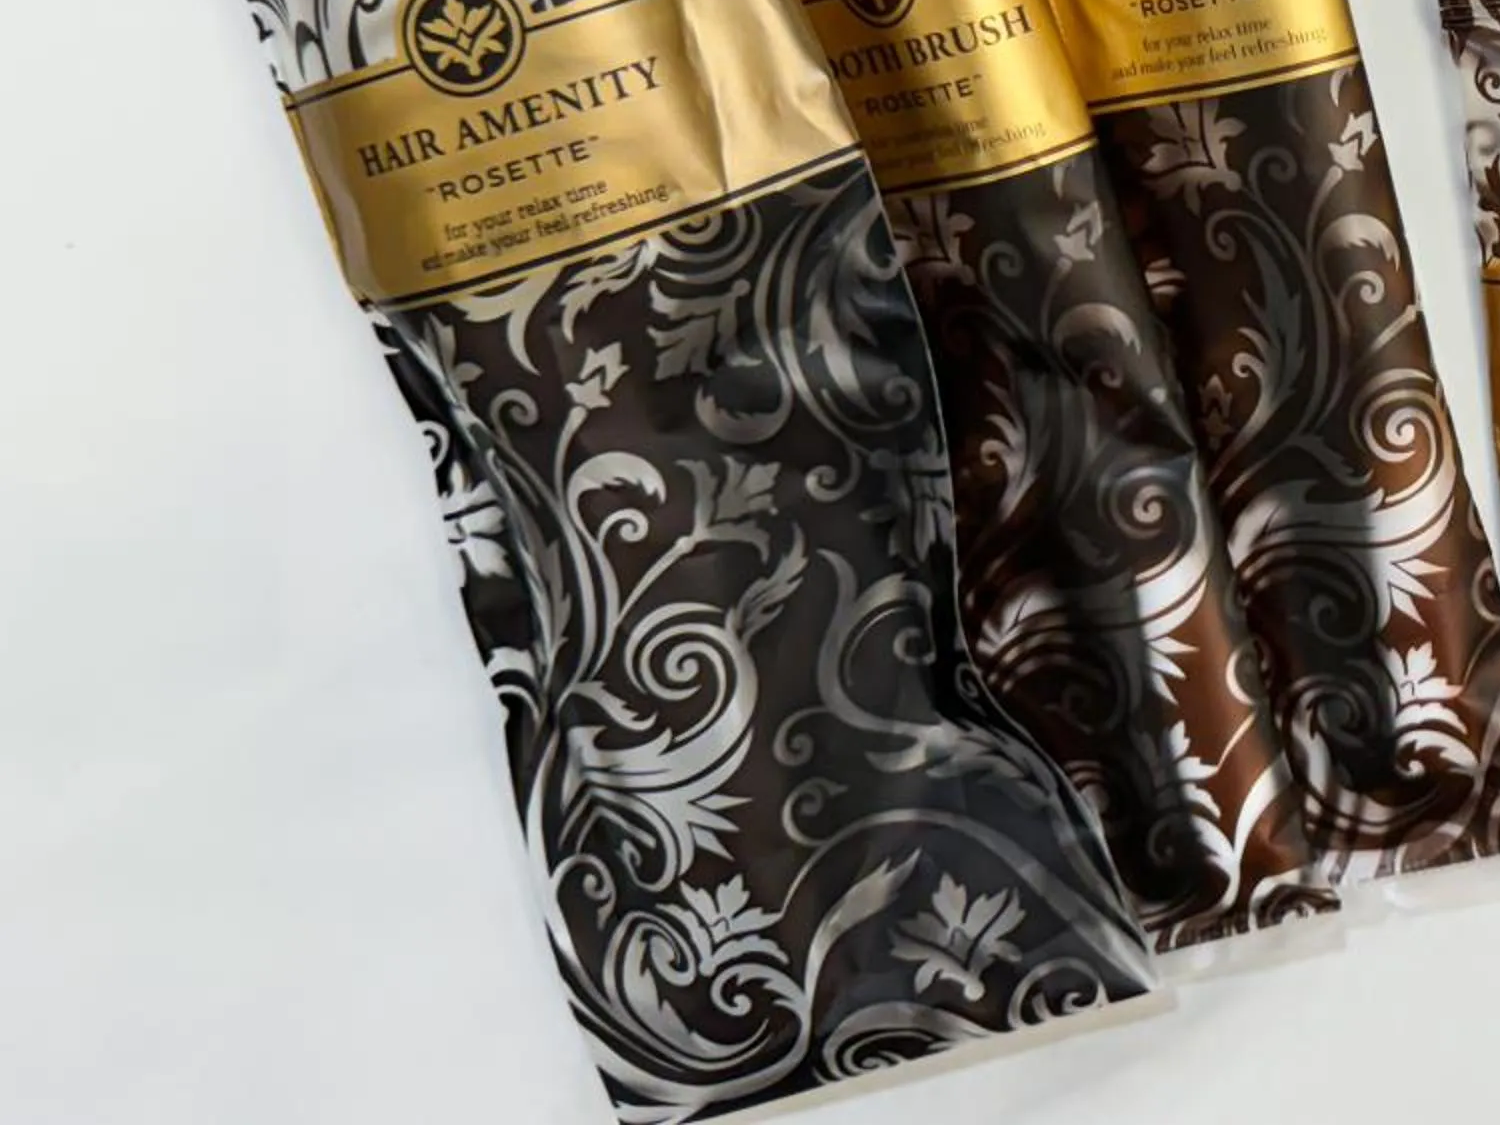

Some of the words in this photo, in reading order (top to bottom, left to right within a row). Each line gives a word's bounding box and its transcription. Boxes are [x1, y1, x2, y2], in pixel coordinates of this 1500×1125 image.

[904, 3, 1033, 68] BRUSH
[1140, 53, 1172, 75] make
[1175, 50, 1206, 72] your
[1208, 42, 1237, 63] feel
[1143, 37, 1161, 54] for
[1165, 31, 1193, 51] your
[1197, 25, 1233, 45] relax
[1236, 18, 1272, 38] time
[357, 126, 447, 178] HAIR
[456, 55, 662, 154] AMENITY
[444, 221, 468, 242] for
[471, 208, 512, 239] your
[517, 195, 563, 221] relax
[565, 178, 609, 203] time
[489, 228, 531, 257] your
[535, 217, 570, 239] feel
[571, 182, 670, 228] refreshing
